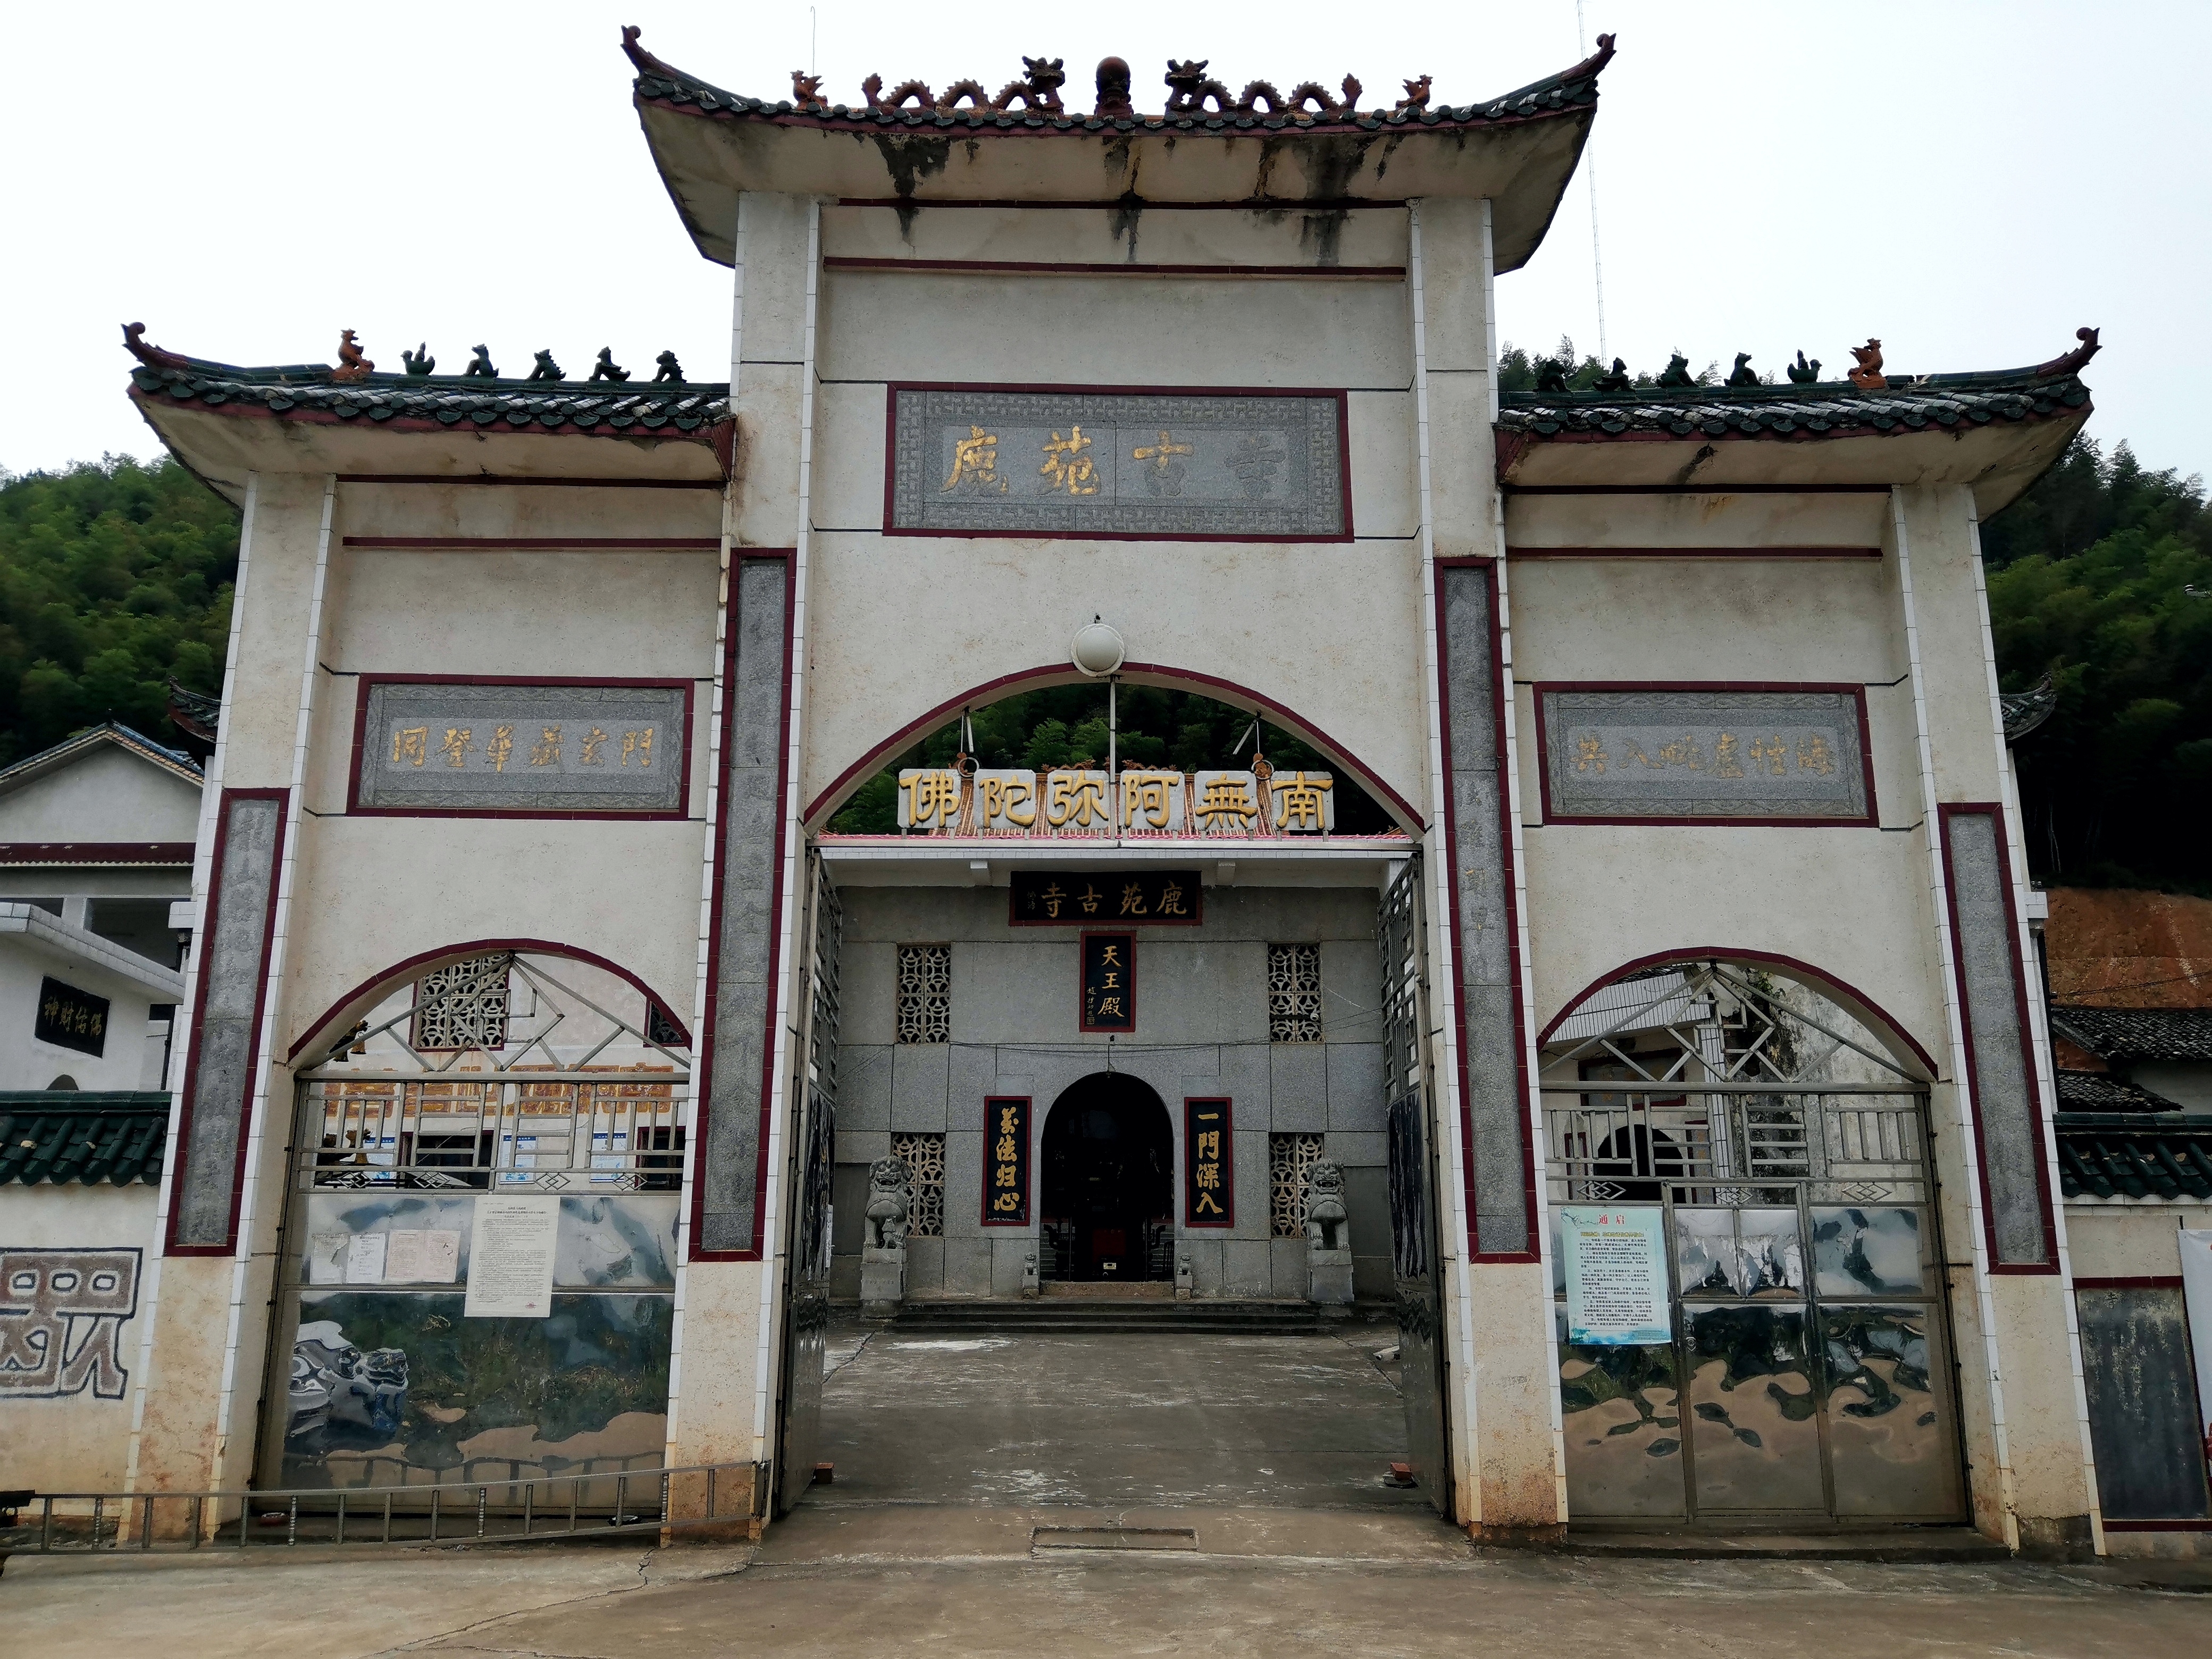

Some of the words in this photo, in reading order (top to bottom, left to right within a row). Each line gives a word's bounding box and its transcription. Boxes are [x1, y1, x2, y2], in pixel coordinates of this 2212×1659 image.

[1097, 945, 1125, 1018] 天王殿
[1196, 1111, 1224, 1214] 一門深入
